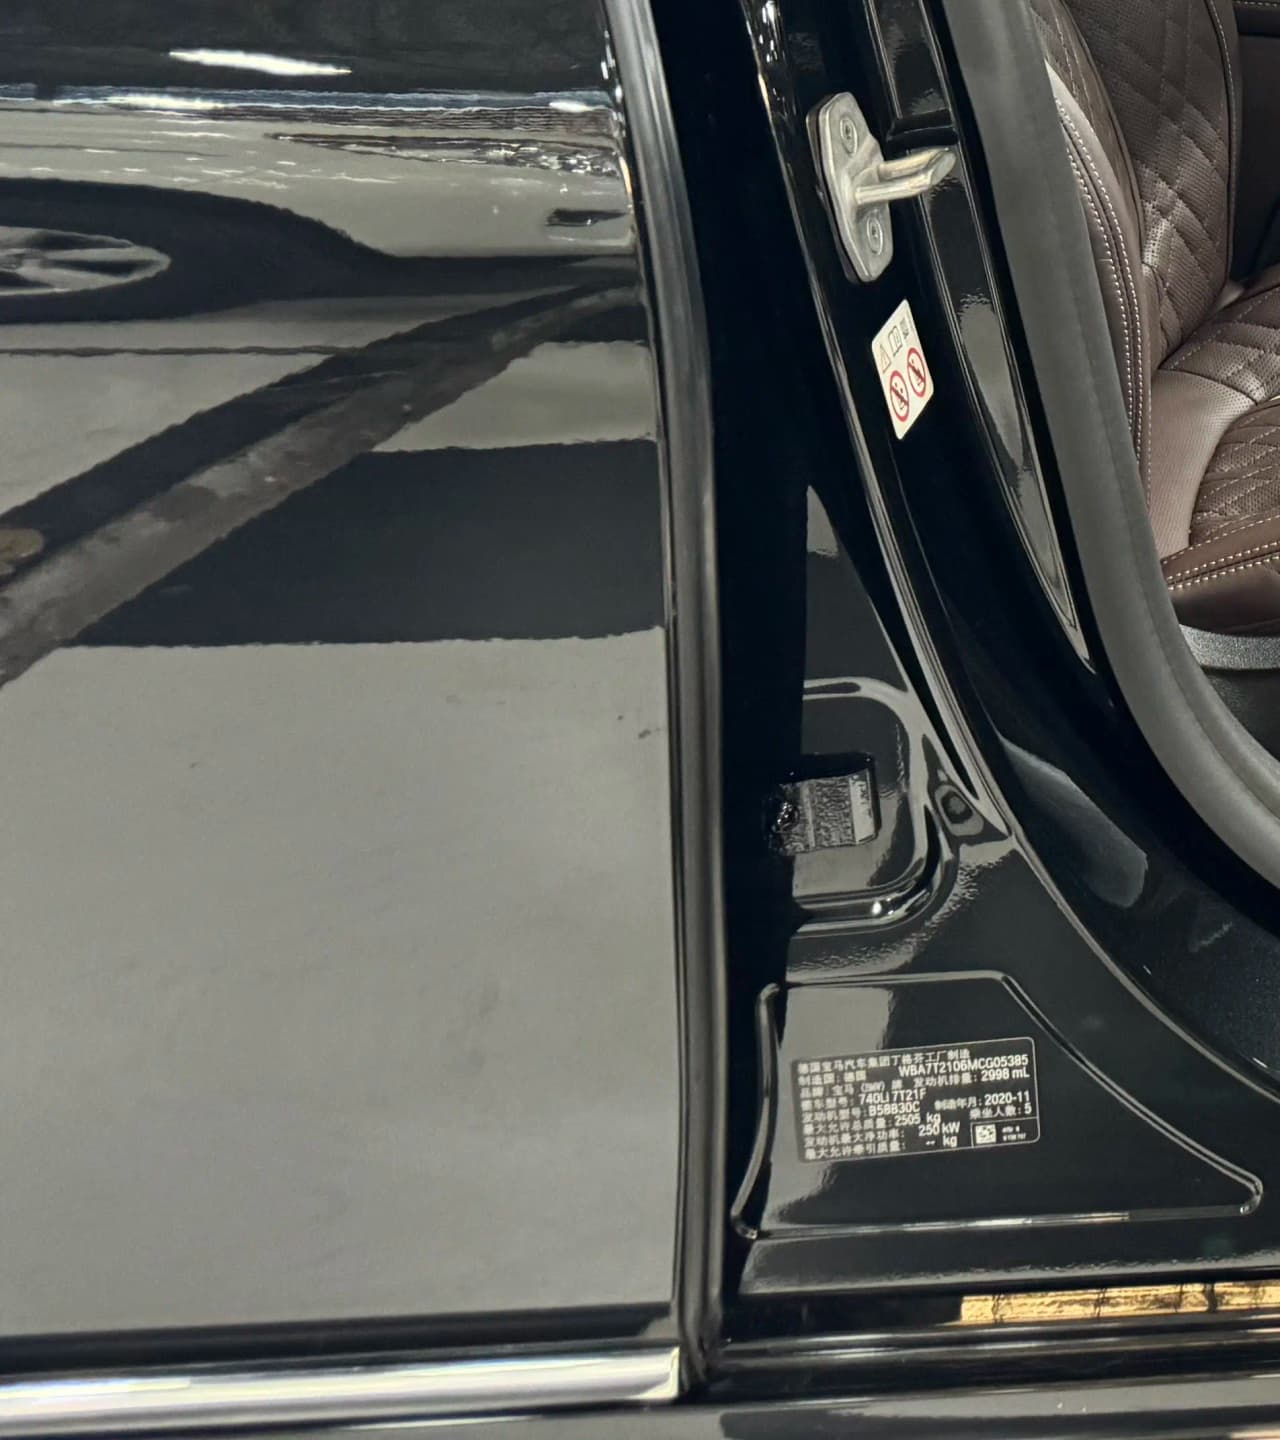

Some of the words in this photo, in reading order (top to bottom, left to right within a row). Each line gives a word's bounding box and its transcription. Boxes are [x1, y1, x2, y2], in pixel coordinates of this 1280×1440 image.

[984, 1090, 1030, 1106] 2020-11
[894, 1113, 921, 1126] 2505
[926, 1112, 941, 1124] kg
[918, 1122, 940, 1137] 250
[941, 1121, 960, 1134] kW
[942, 1135, 958, 1148] kg
